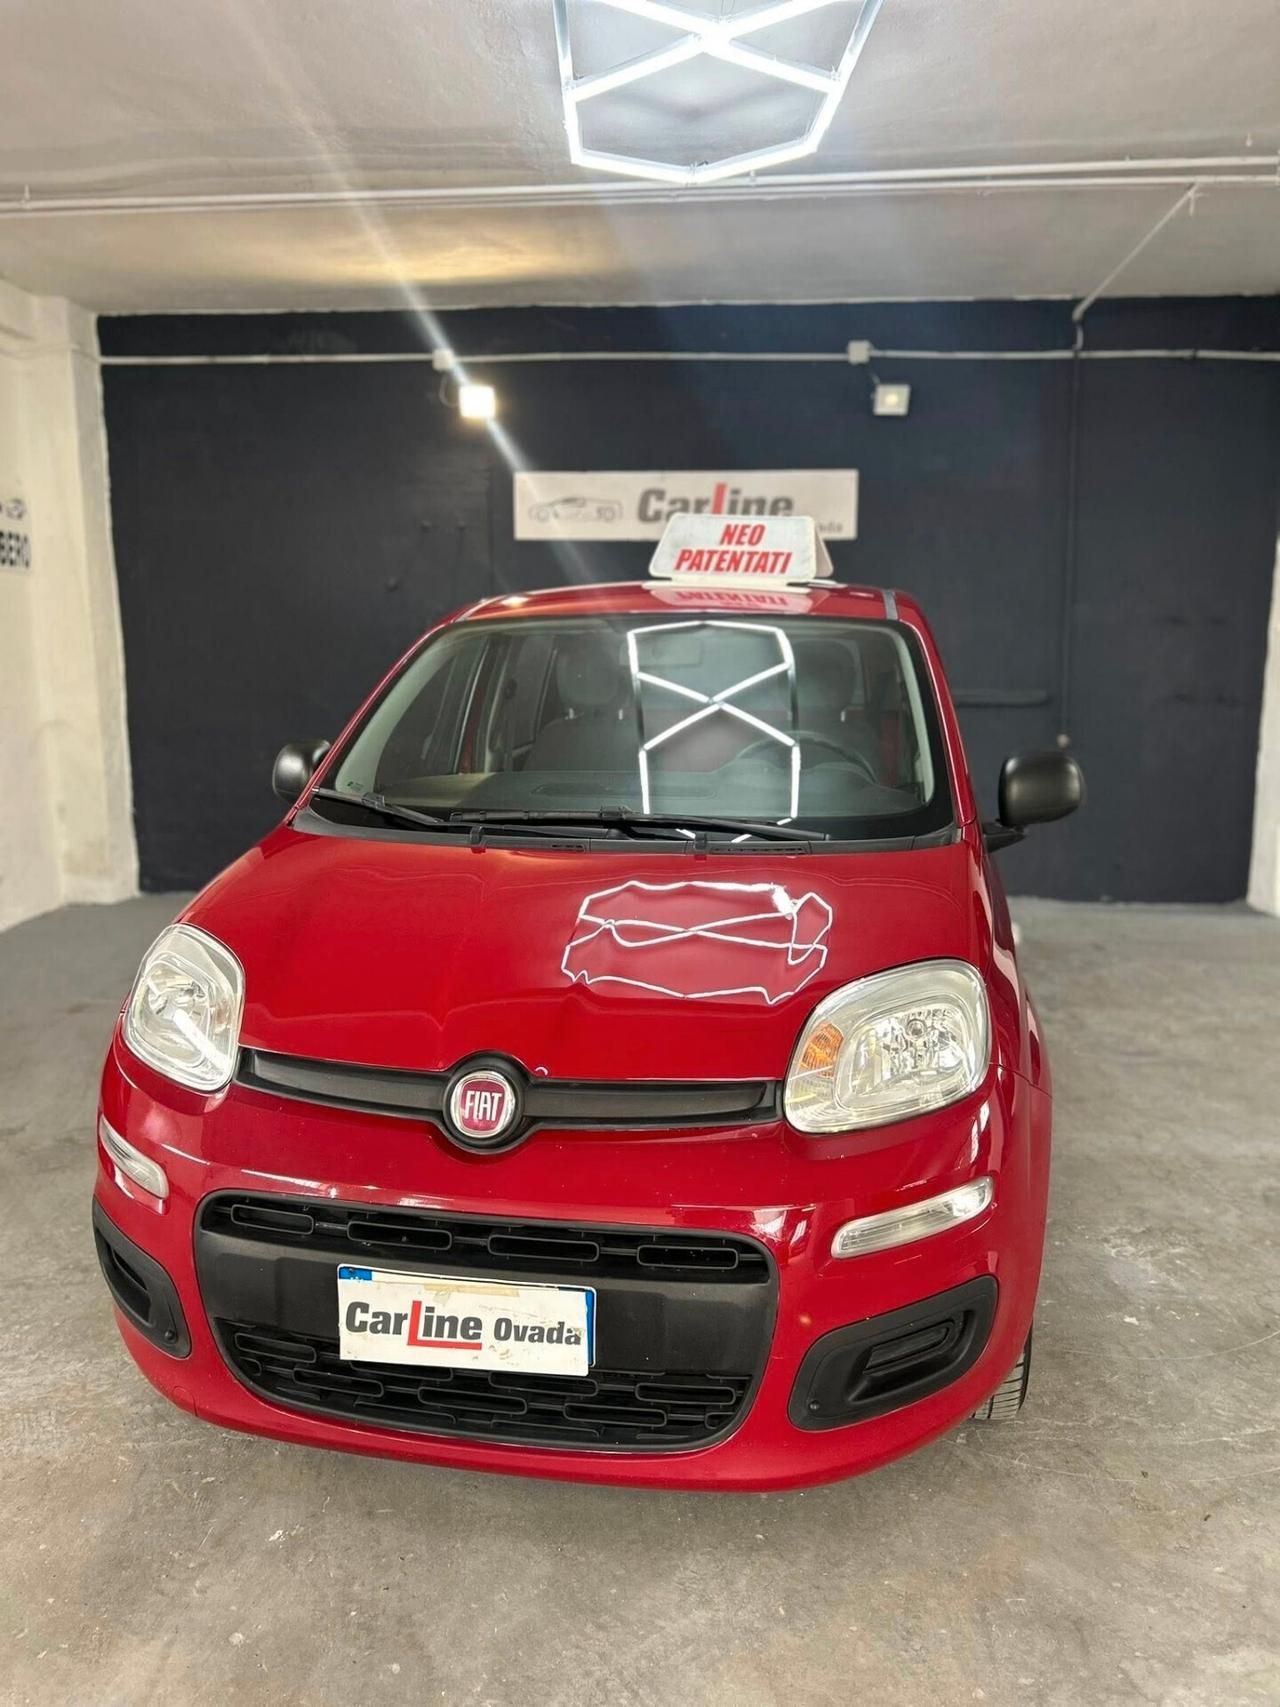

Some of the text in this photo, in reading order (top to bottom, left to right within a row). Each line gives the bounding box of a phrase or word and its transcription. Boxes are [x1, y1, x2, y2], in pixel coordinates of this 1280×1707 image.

[720, 523, 766, 546] NEO
[674, 549, 792, 574] PATENTATI
[464, 1090, 502, 1121] FIAT
[493, 1316, 582, 1346] Ovada
